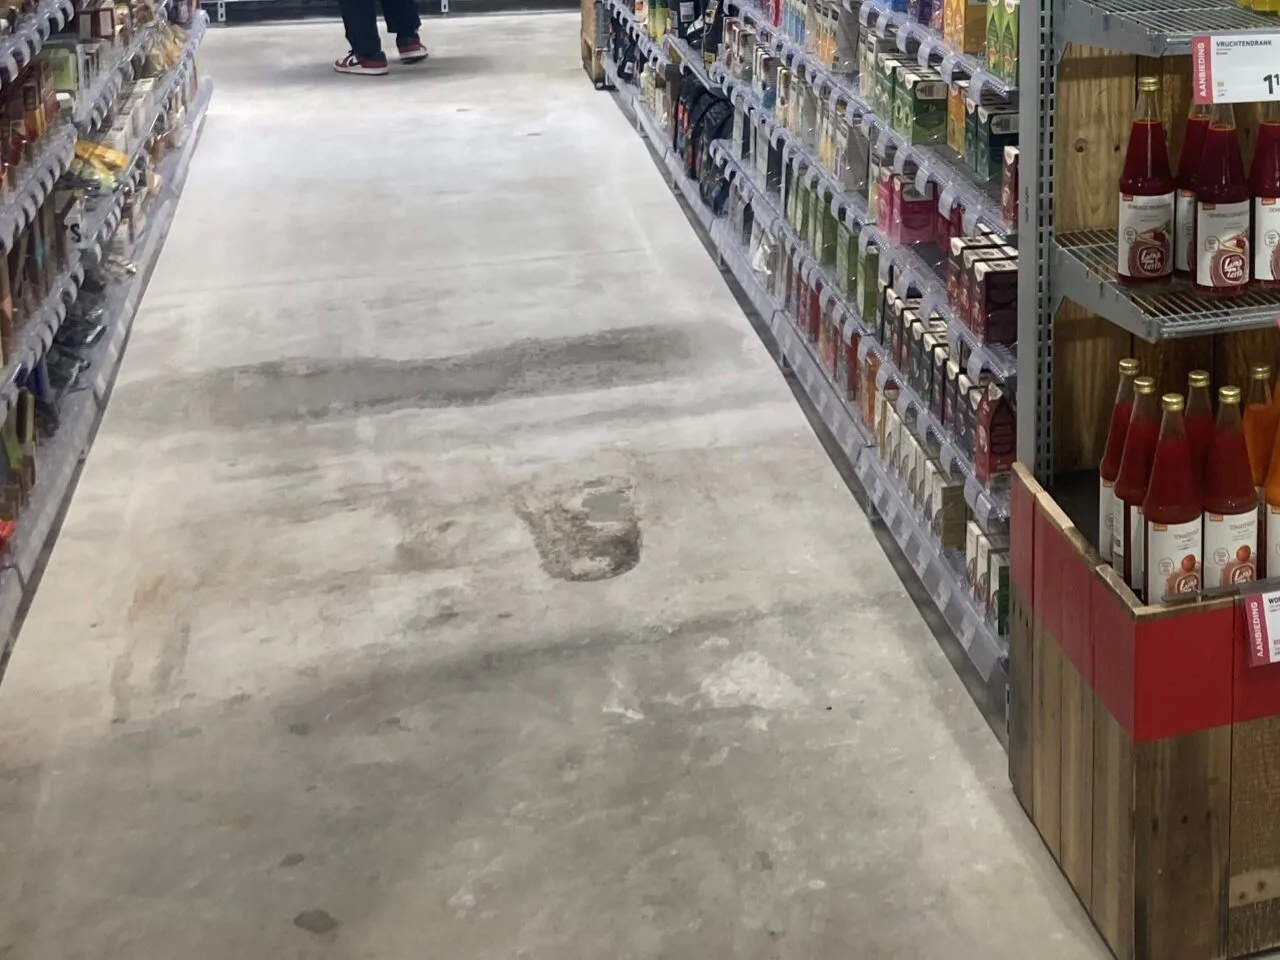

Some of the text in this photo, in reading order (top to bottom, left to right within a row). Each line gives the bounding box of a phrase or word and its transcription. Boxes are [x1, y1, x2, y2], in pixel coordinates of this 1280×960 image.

[1197, 42, 1206, 97] AANBIEDING
[1216, 40, 1272, 48] VRUCHTENDRANK
[1250, 601, 1264, 657] AANBIEDING
